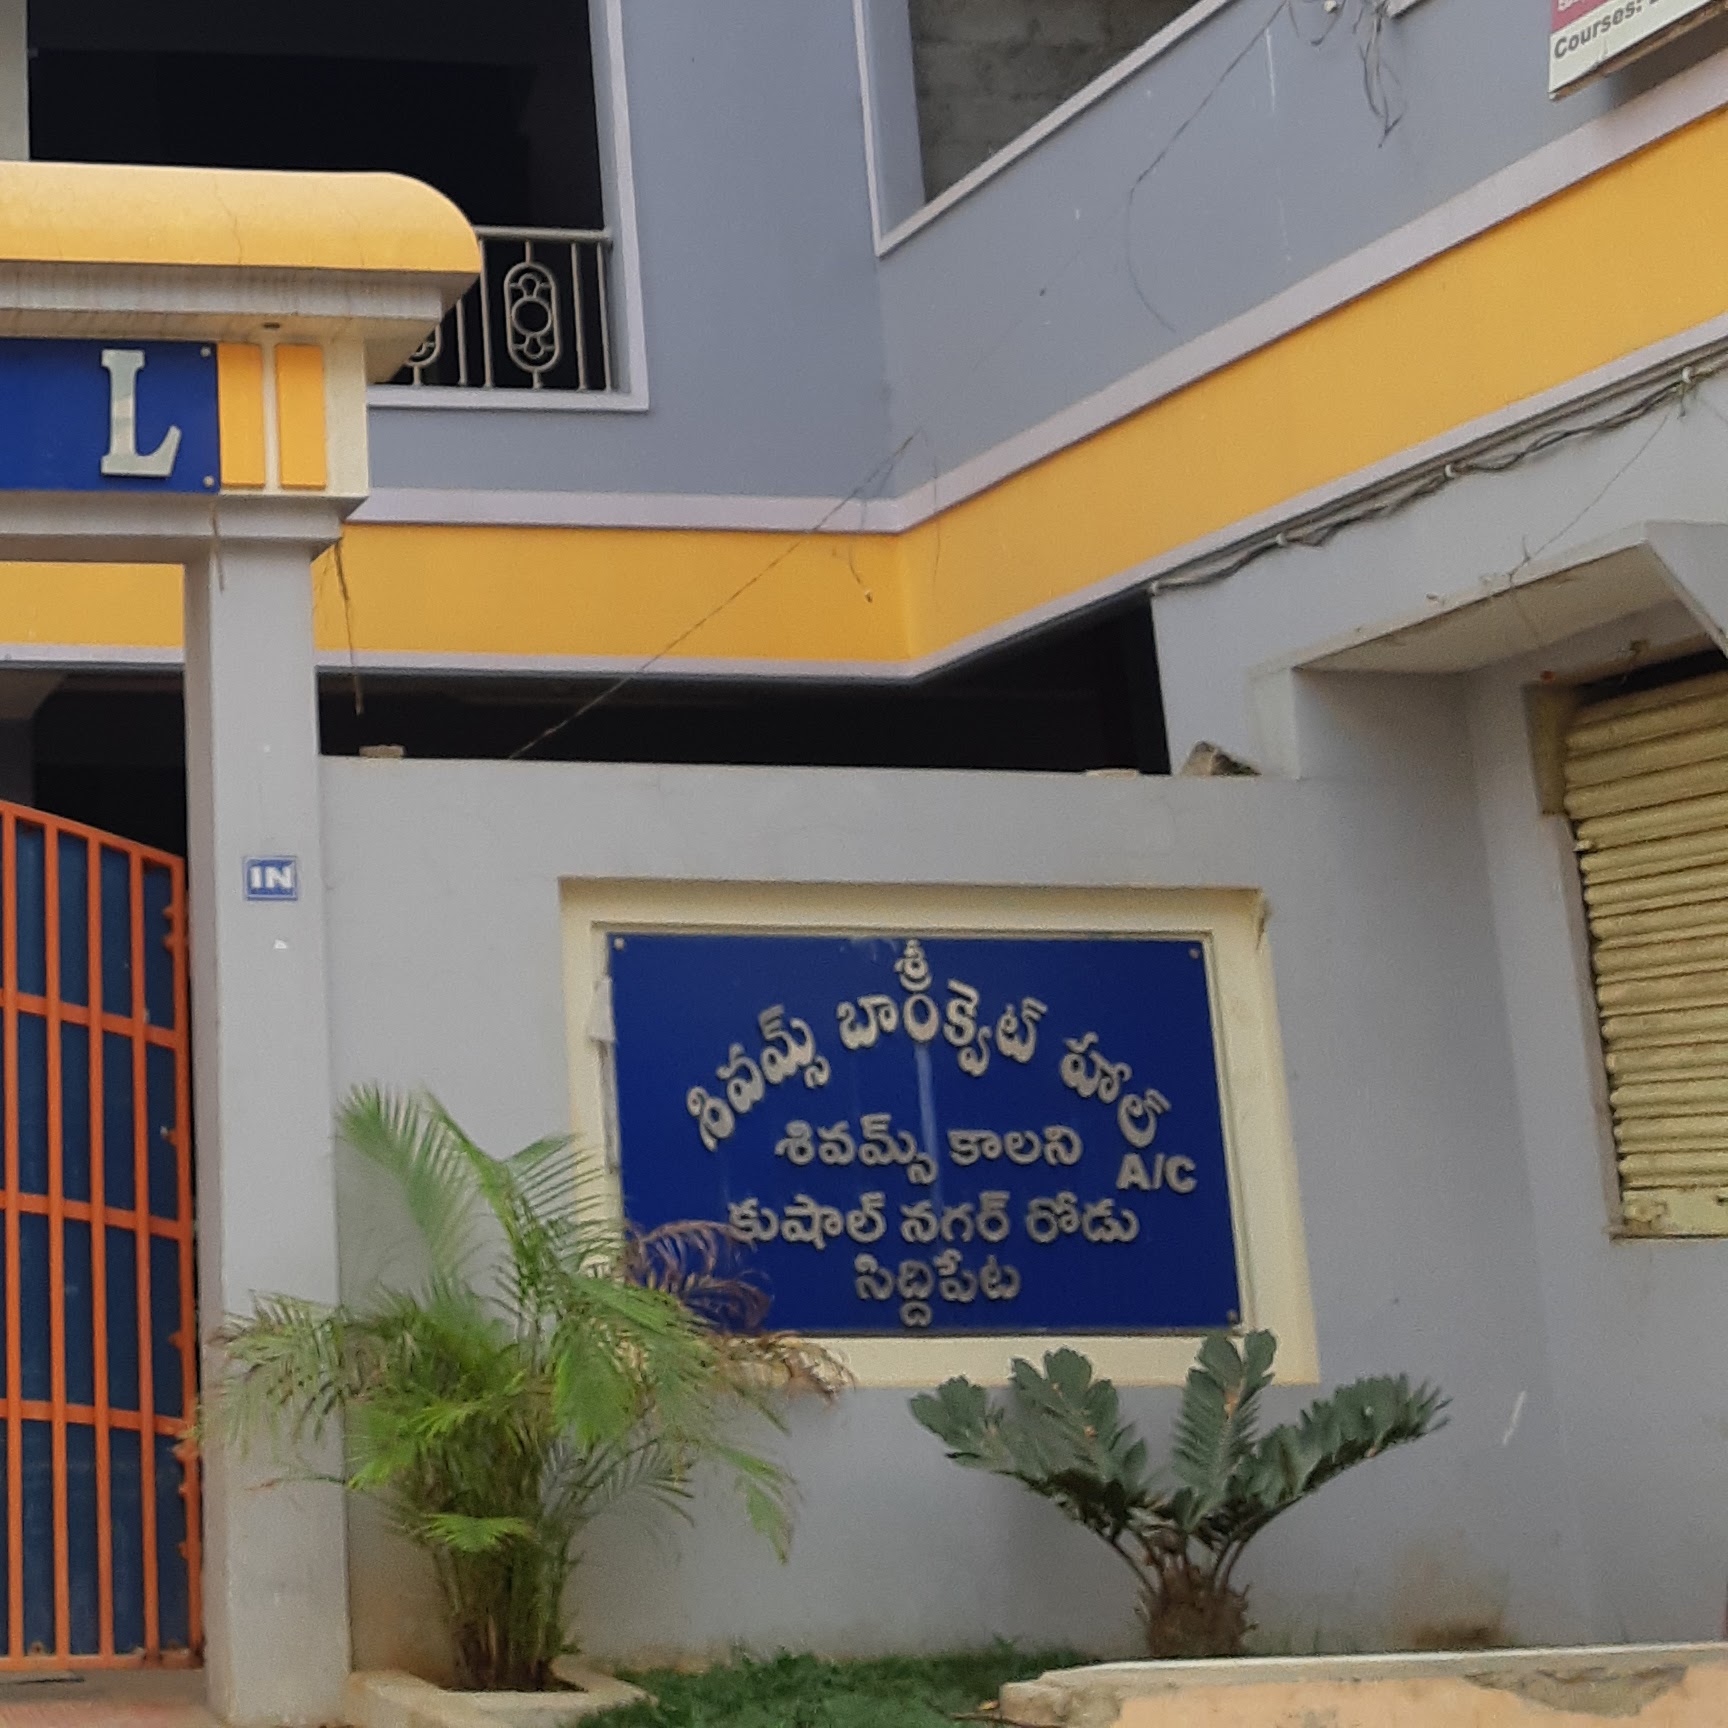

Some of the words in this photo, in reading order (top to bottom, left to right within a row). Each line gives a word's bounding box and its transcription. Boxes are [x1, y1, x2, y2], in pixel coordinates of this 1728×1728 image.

[250, 866, 292, 889] IN
[1059, 1030, 1172, 1149] హాల్
[1115, 1151, 1198, 1194] A/C
[728, 1190, 887, 1250] కుషాల్
[899, 1190, 1010, 1244] నగర్
